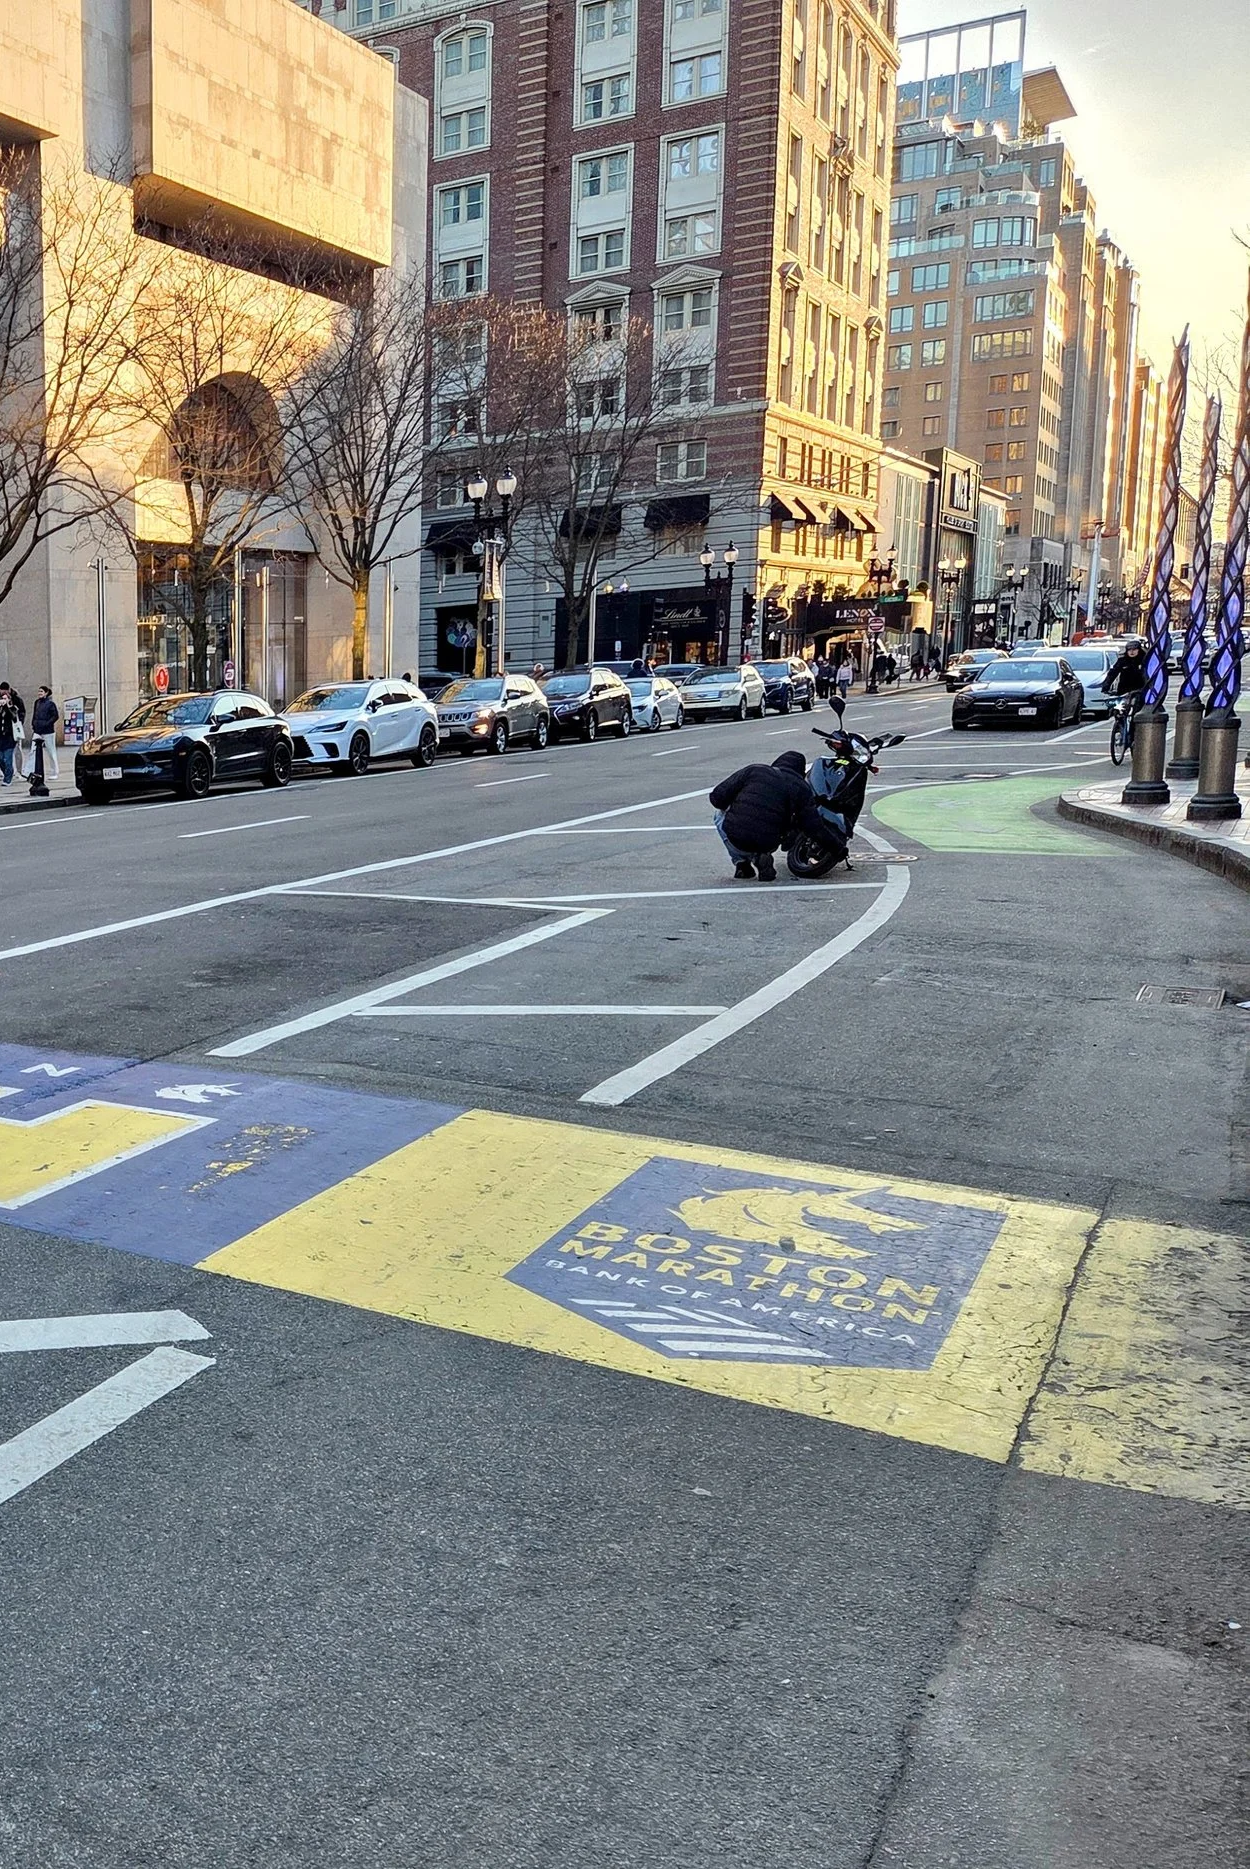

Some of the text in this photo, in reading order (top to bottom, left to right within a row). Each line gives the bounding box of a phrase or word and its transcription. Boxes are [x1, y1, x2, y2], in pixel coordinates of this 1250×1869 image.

[664, 608, 694, 619] Lindt
[835, 608, 876, 619] LENOX
[545, 1259, 916, 1346] BANK OF AMERICA
[558, 1239, 930, 1325] MARATHON
[575, 1220, 941, 1306] BOSTON
